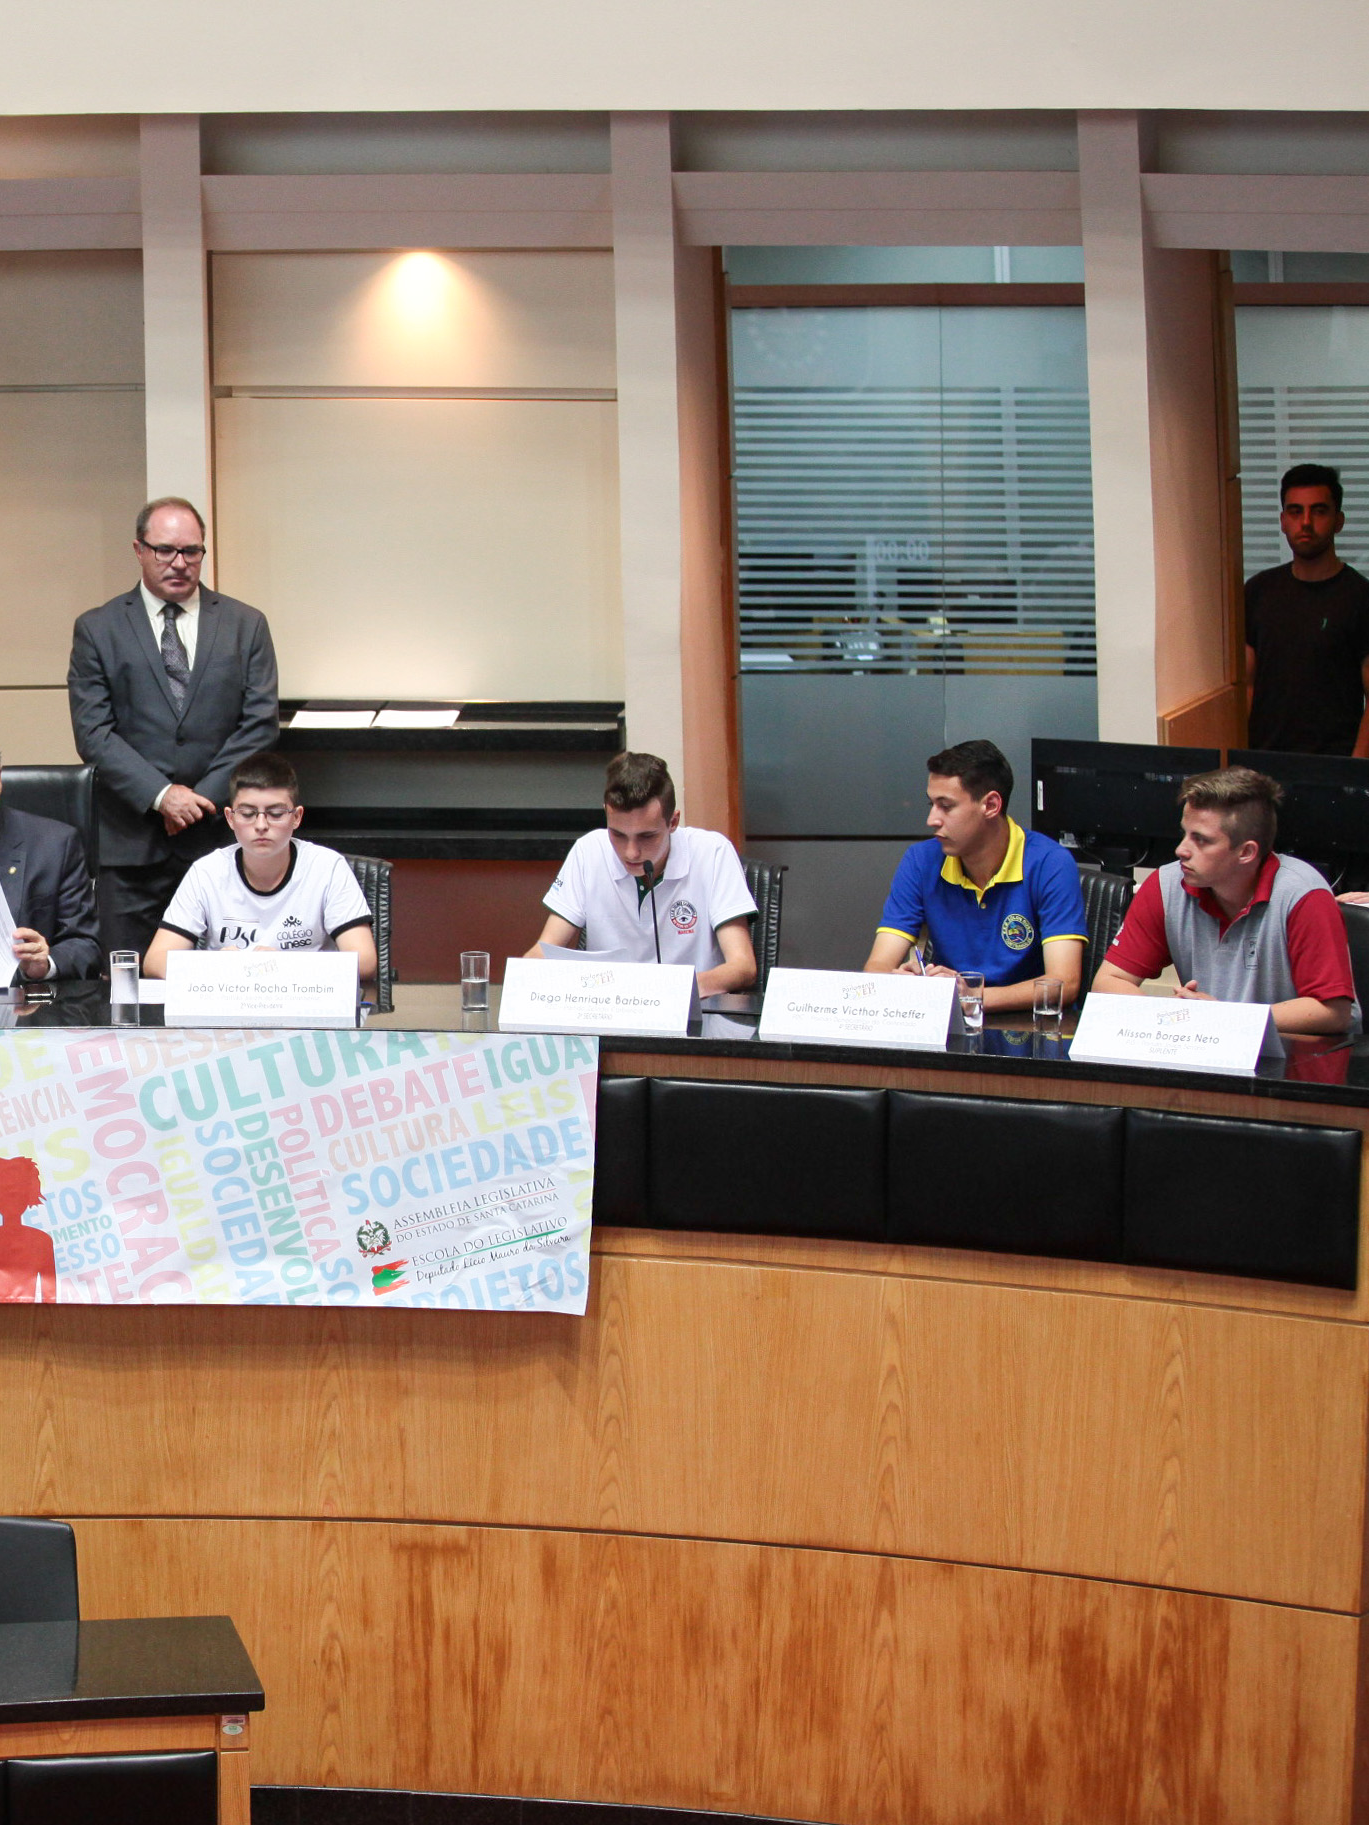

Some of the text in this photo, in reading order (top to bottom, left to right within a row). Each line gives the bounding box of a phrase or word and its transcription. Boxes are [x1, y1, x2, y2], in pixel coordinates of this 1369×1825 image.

[276, 928, 313, 941] COLÉGIO
[280, 938, 312, 950] unesc
[188, 983, 334, 994] João Victor Rocha Trombim
[531, 991, 661, 1006] Diego Henrique Barbiero
[787, 1001, 926, 1019] Guilherme Victhor Scheffer
[483, 1035, 599, 1089] IGUA
[1117, 1029, 1220, 1044] Alisson Borges Neto
[139, 1030, 429, 1131] CULTURA
[310, 1053, 486, 1138] DEBATE
[471, 1079, 577, 1134] LEIS
[328, 1107, 471, 1173] CULTURA
[341, 1117, 588, 1215] SOCIEDADE
[235, 1111, 321, 1305] DESENVOL
[269, 1103, 343, 1263] POLÍTICA
[394, 1177, 556, 1230] ASSEMBLEIA LEGISLATIVA
[396, 1193, 559, 1243] DO ESTADO DE SANTA CATARINA
[412, 1216, 568, 1266] ESCOLA DO LEGISLATIVO
[416, 1261, 460, 1284] Deputado
[489, 1247, 520, 1264] Mauro
[522, 1240, 535, 1252] da
[536, 1233, 571, 1250] Silveira
